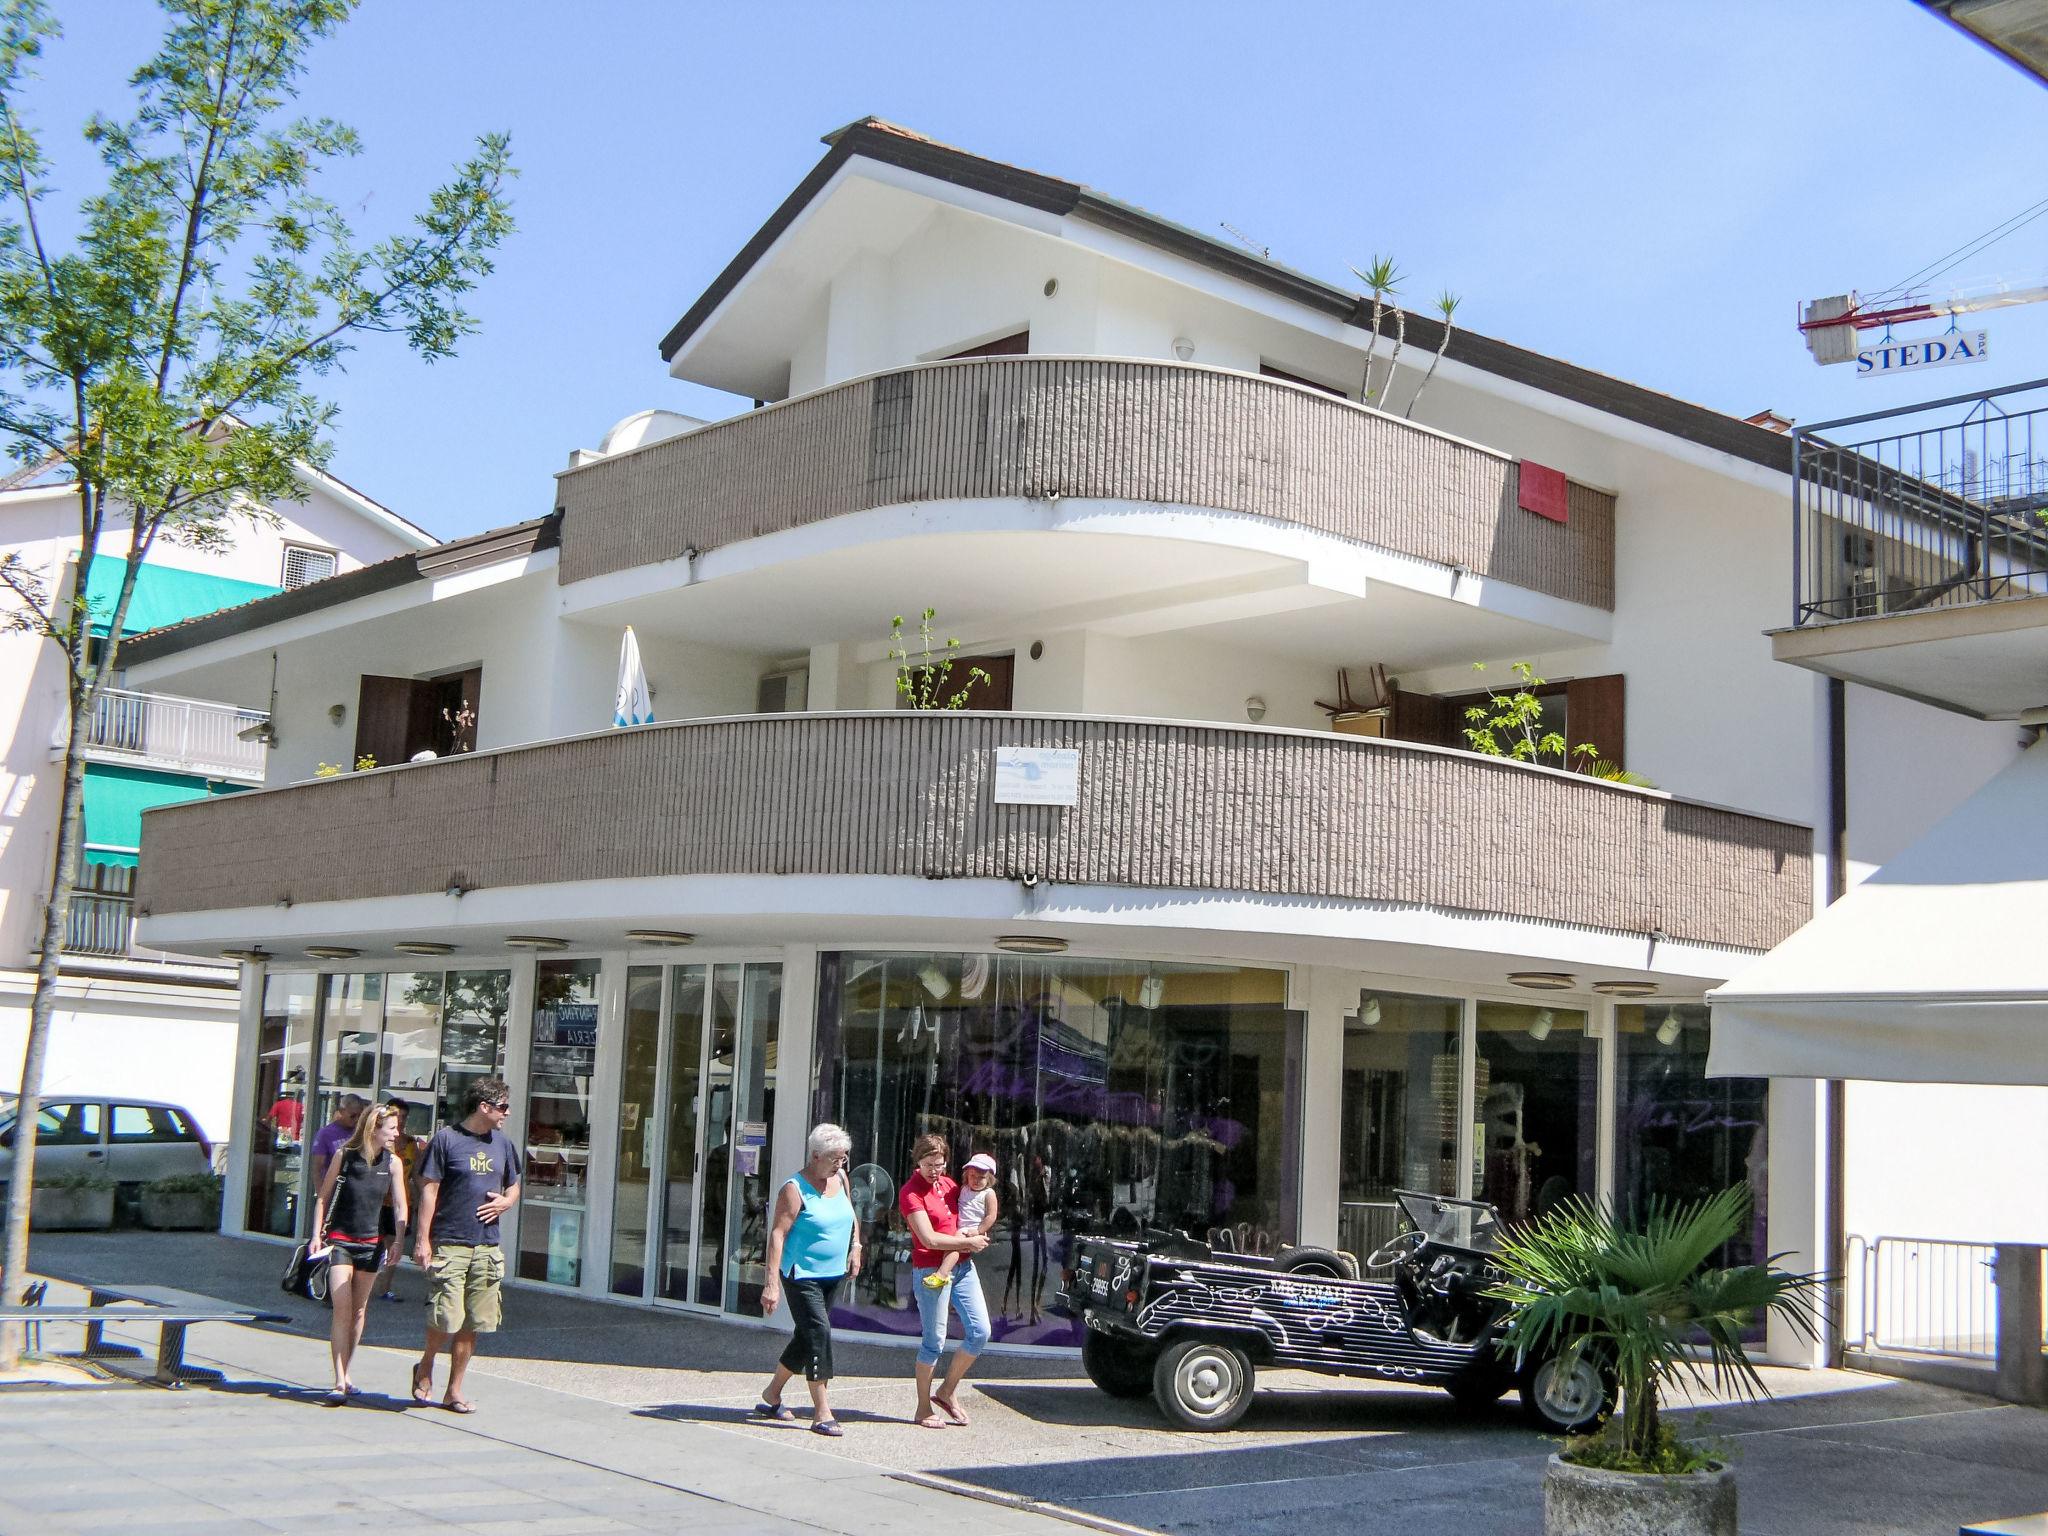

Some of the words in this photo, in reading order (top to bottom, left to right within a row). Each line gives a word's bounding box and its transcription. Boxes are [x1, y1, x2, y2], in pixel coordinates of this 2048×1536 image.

[1857, 339, 1975, 373] STEDA
[1977, 332, 1987, 356] SPA
[470, 1157, 494, 1172] RMC
